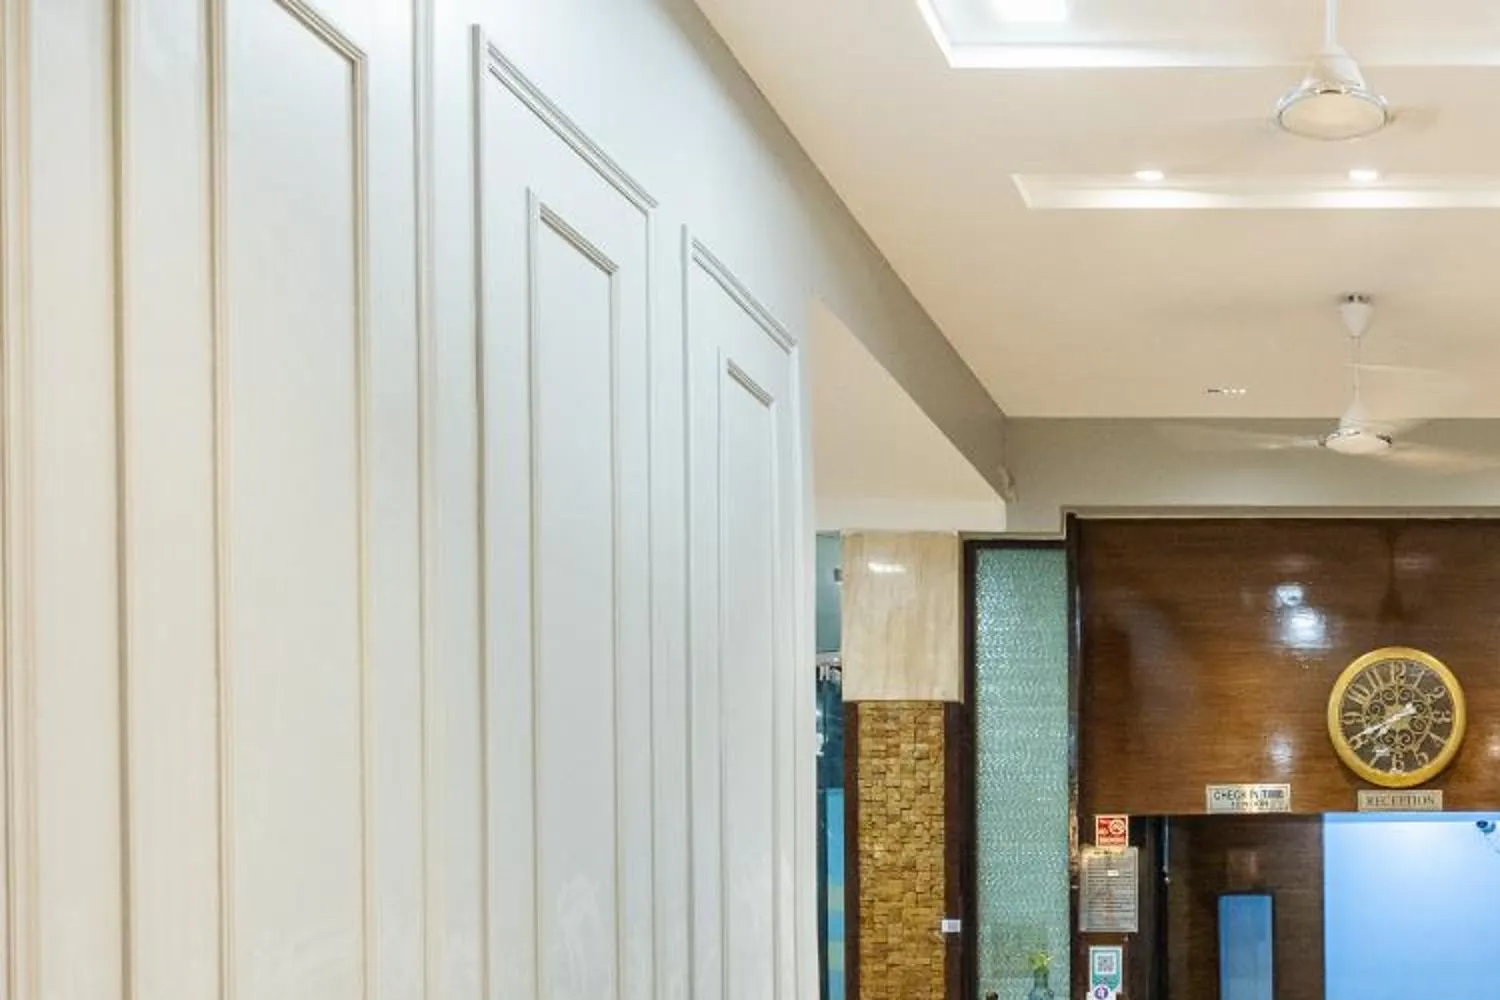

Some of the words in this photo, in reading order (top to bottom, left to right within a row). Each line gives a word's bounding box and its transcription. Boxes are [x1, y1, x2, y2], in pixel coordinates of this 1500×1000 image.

[1366, 668, 1385, 690] 11
[1391, 662, 1407, 685] 12
[1412, 669, 1425, 689] 1
[1348, 684, 1371, 705] 10
[1426, 686, 1447, 705] 2
[1343, 711, 1363, 725] 9
[1433, 710, 1452, 724] 3
[1391, 752, 1405, 774] 6
[1366, 795, 1435, 806] RECEPTION
